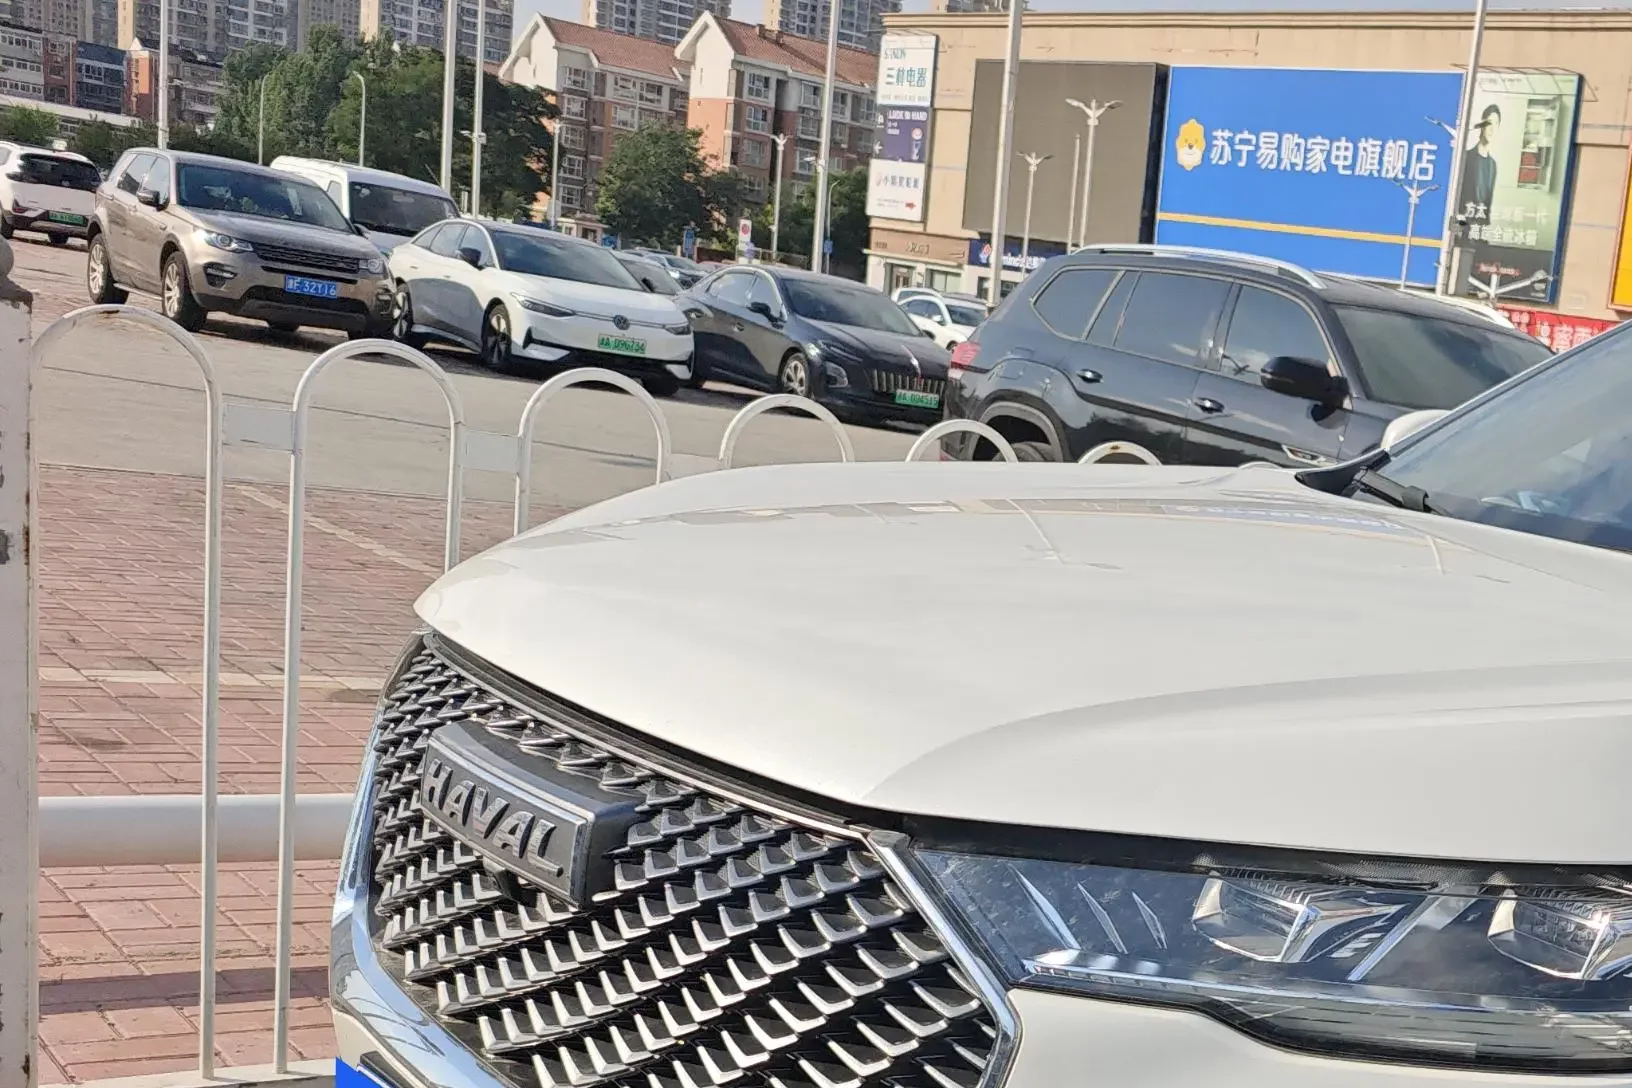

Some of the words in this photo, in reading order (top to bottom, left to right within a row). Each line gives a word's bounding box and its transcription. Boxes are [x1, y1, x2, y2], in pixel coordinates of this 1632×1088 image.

[1210, 128, 1438, 182] 苏宁易购家电旗舰店
[424, 758, 564, 878] HAVAL
